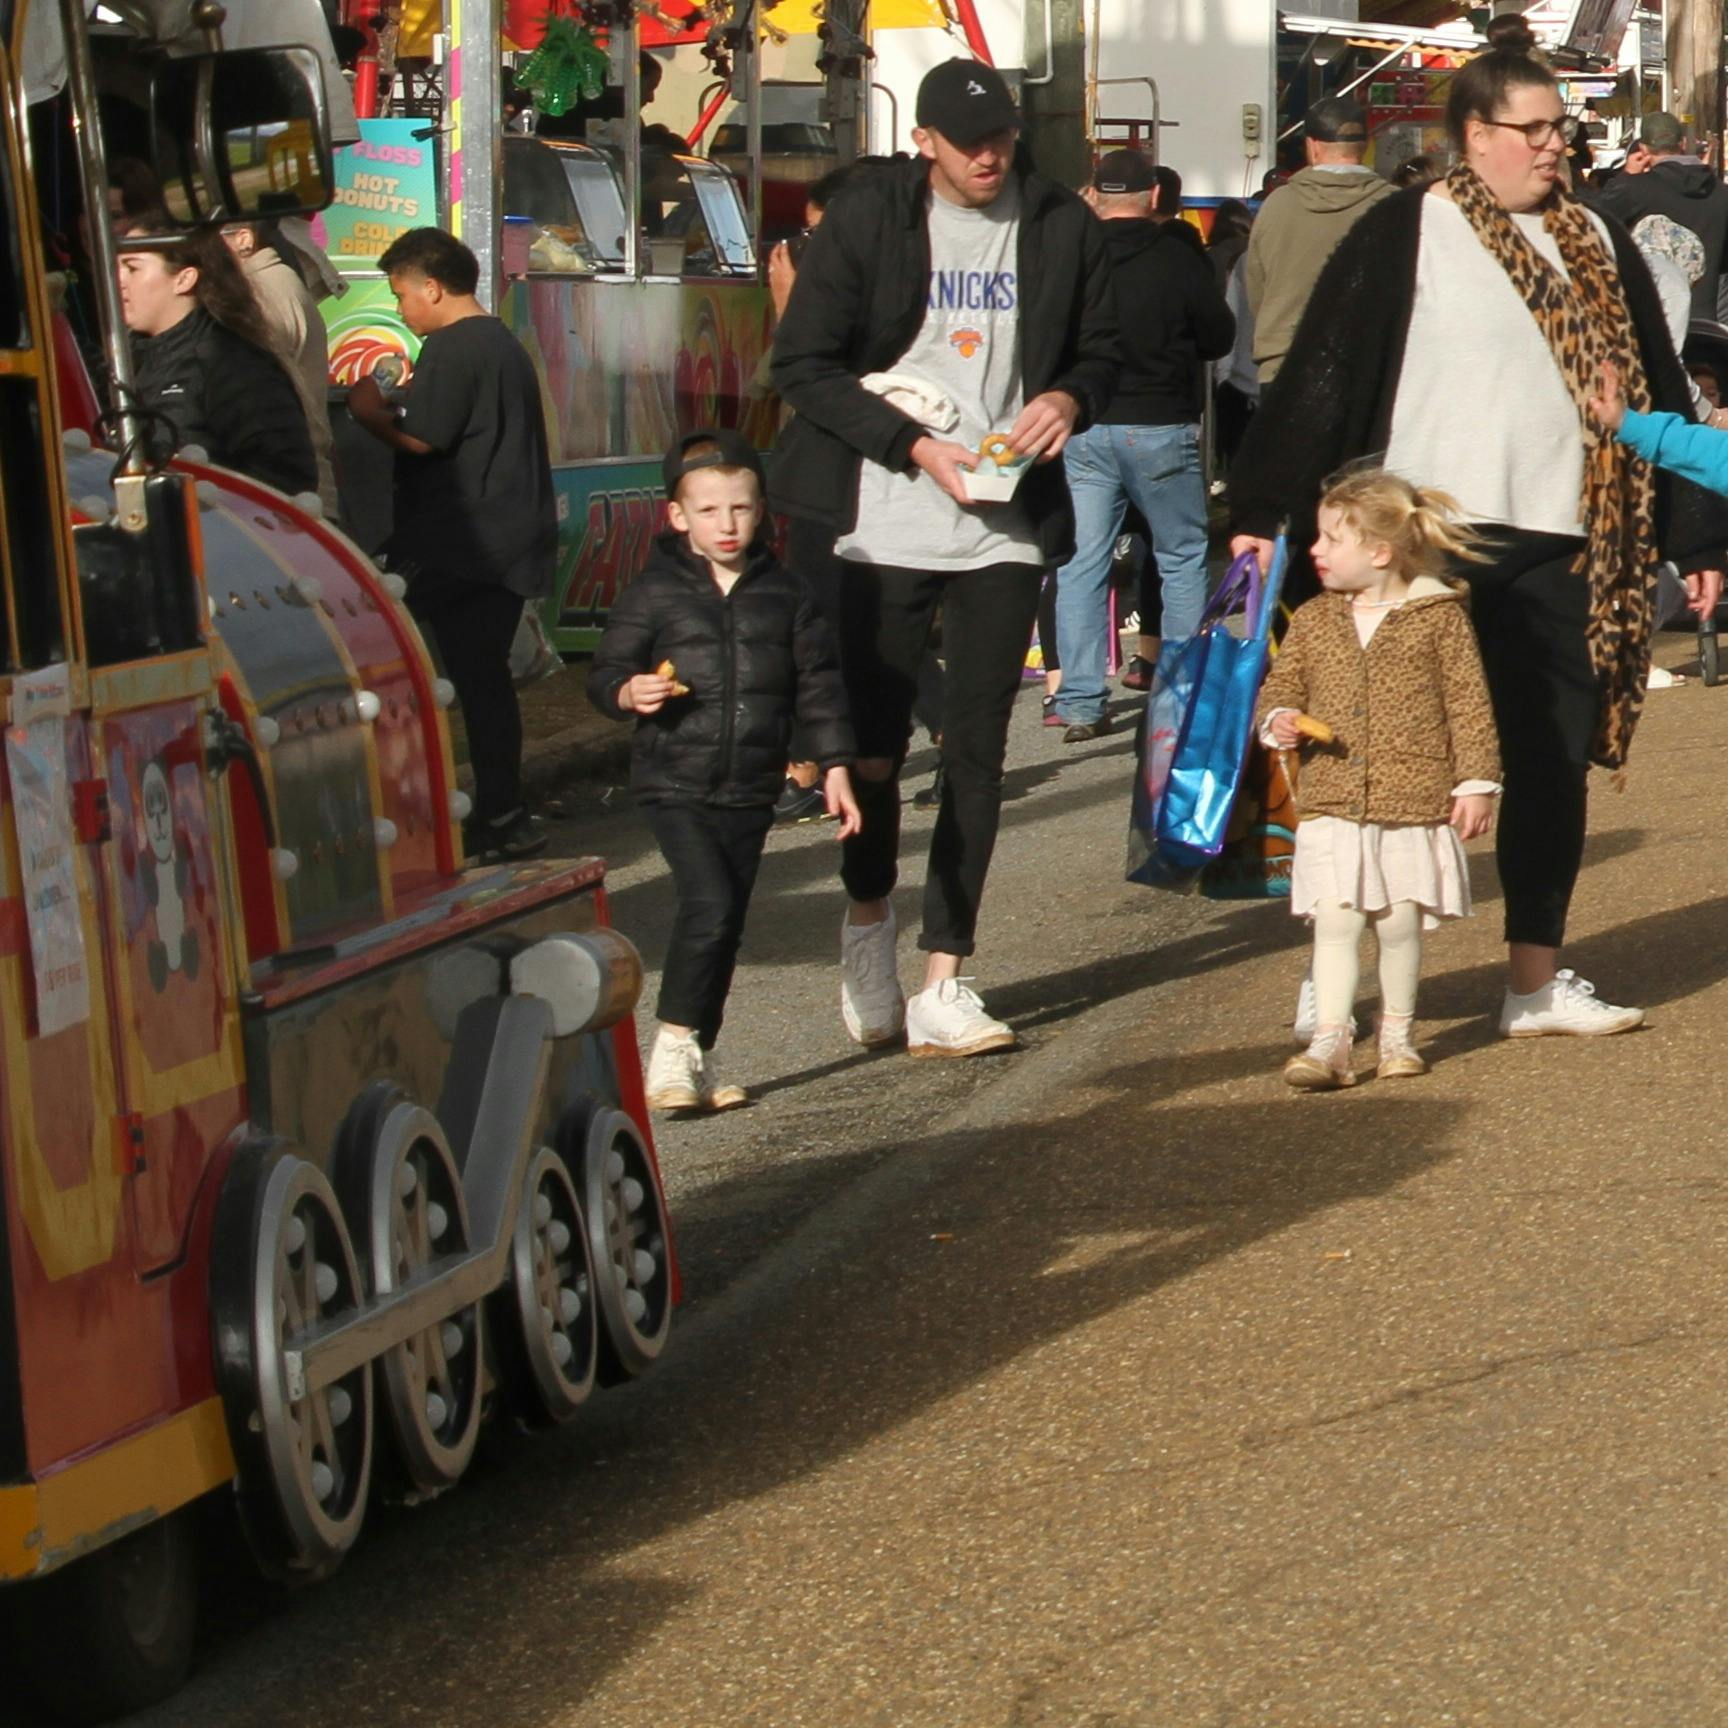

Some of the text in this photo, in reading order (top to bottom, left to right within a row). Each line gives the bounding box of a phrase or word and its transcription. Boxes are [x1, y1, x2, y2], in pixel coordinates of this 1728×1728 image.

[351, 141, 422, 168] FLOSS
[353, 171, 399, 195] HOT
[339, 236, 388, 256] DRI
